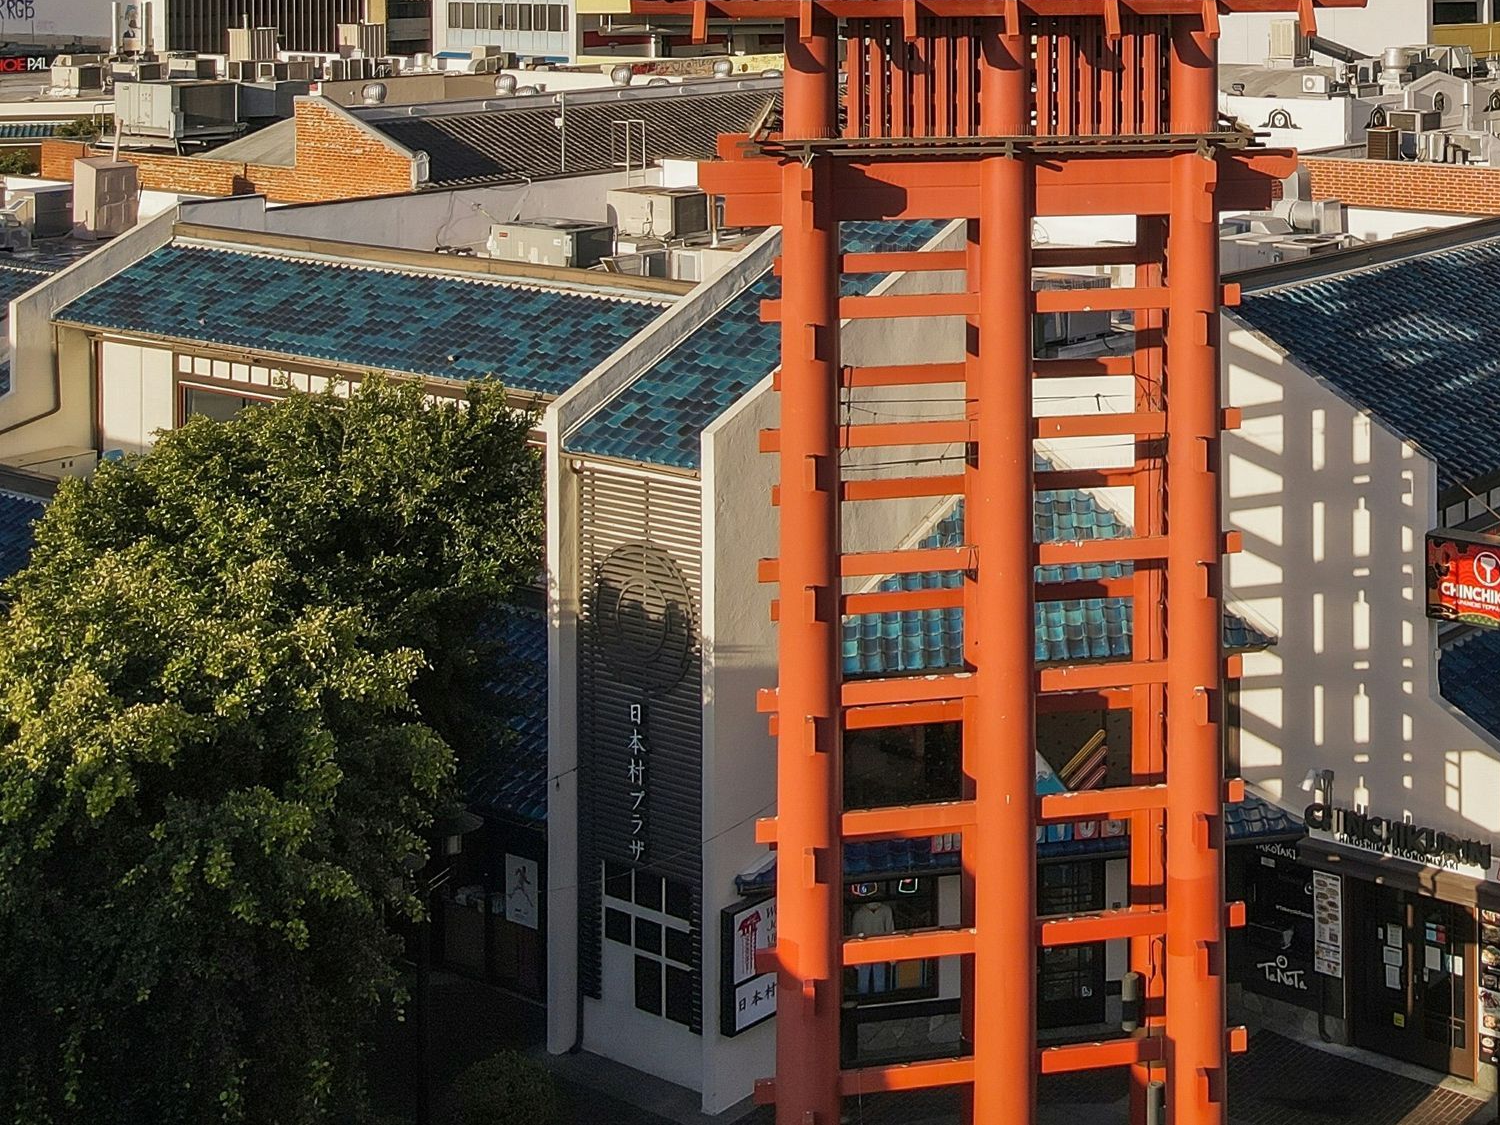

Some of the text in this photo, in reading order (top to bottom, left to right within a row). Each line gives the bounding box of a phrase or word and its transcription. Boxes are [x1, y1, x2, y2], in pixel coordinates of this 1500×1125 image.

[627, 704, 647, 861] 日本村プラザ
[1391, 846, 1459, 871] OKONOMIYAKI
[738, 981, 777, 1012] 日本村
